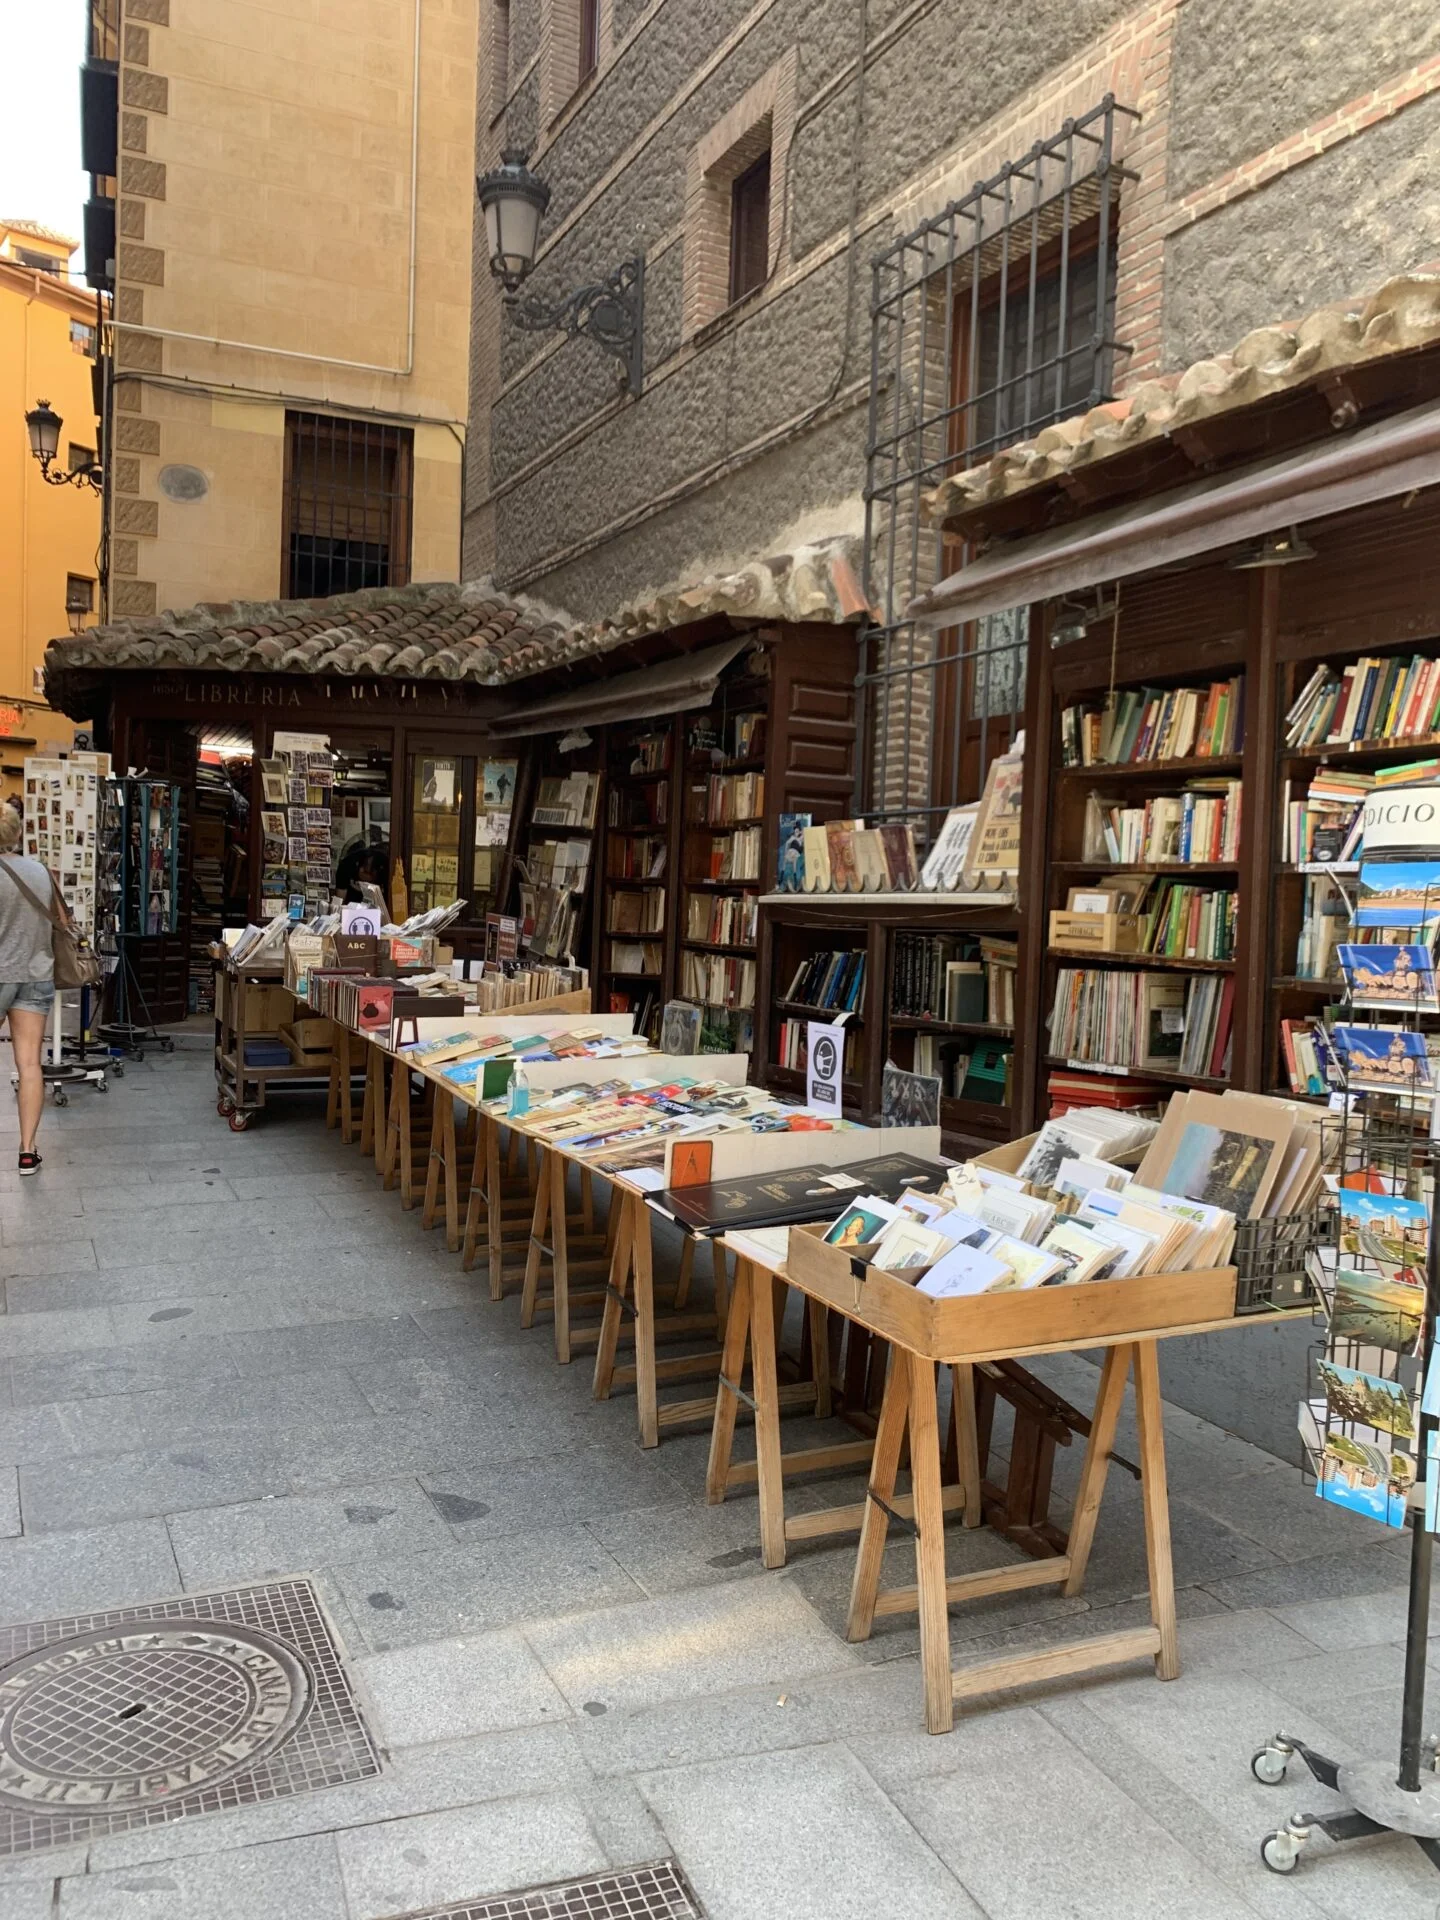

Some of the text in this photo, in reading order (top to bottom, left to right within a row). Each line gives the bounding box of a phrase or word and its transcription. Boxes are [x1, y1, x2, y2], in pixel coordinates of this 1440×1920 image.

[184, 683, 302, 706] LIBRERIA
[347, 942, 366, 950] ABC
[32, 1654, 290, 1801] CANAL DE ISABEL II
